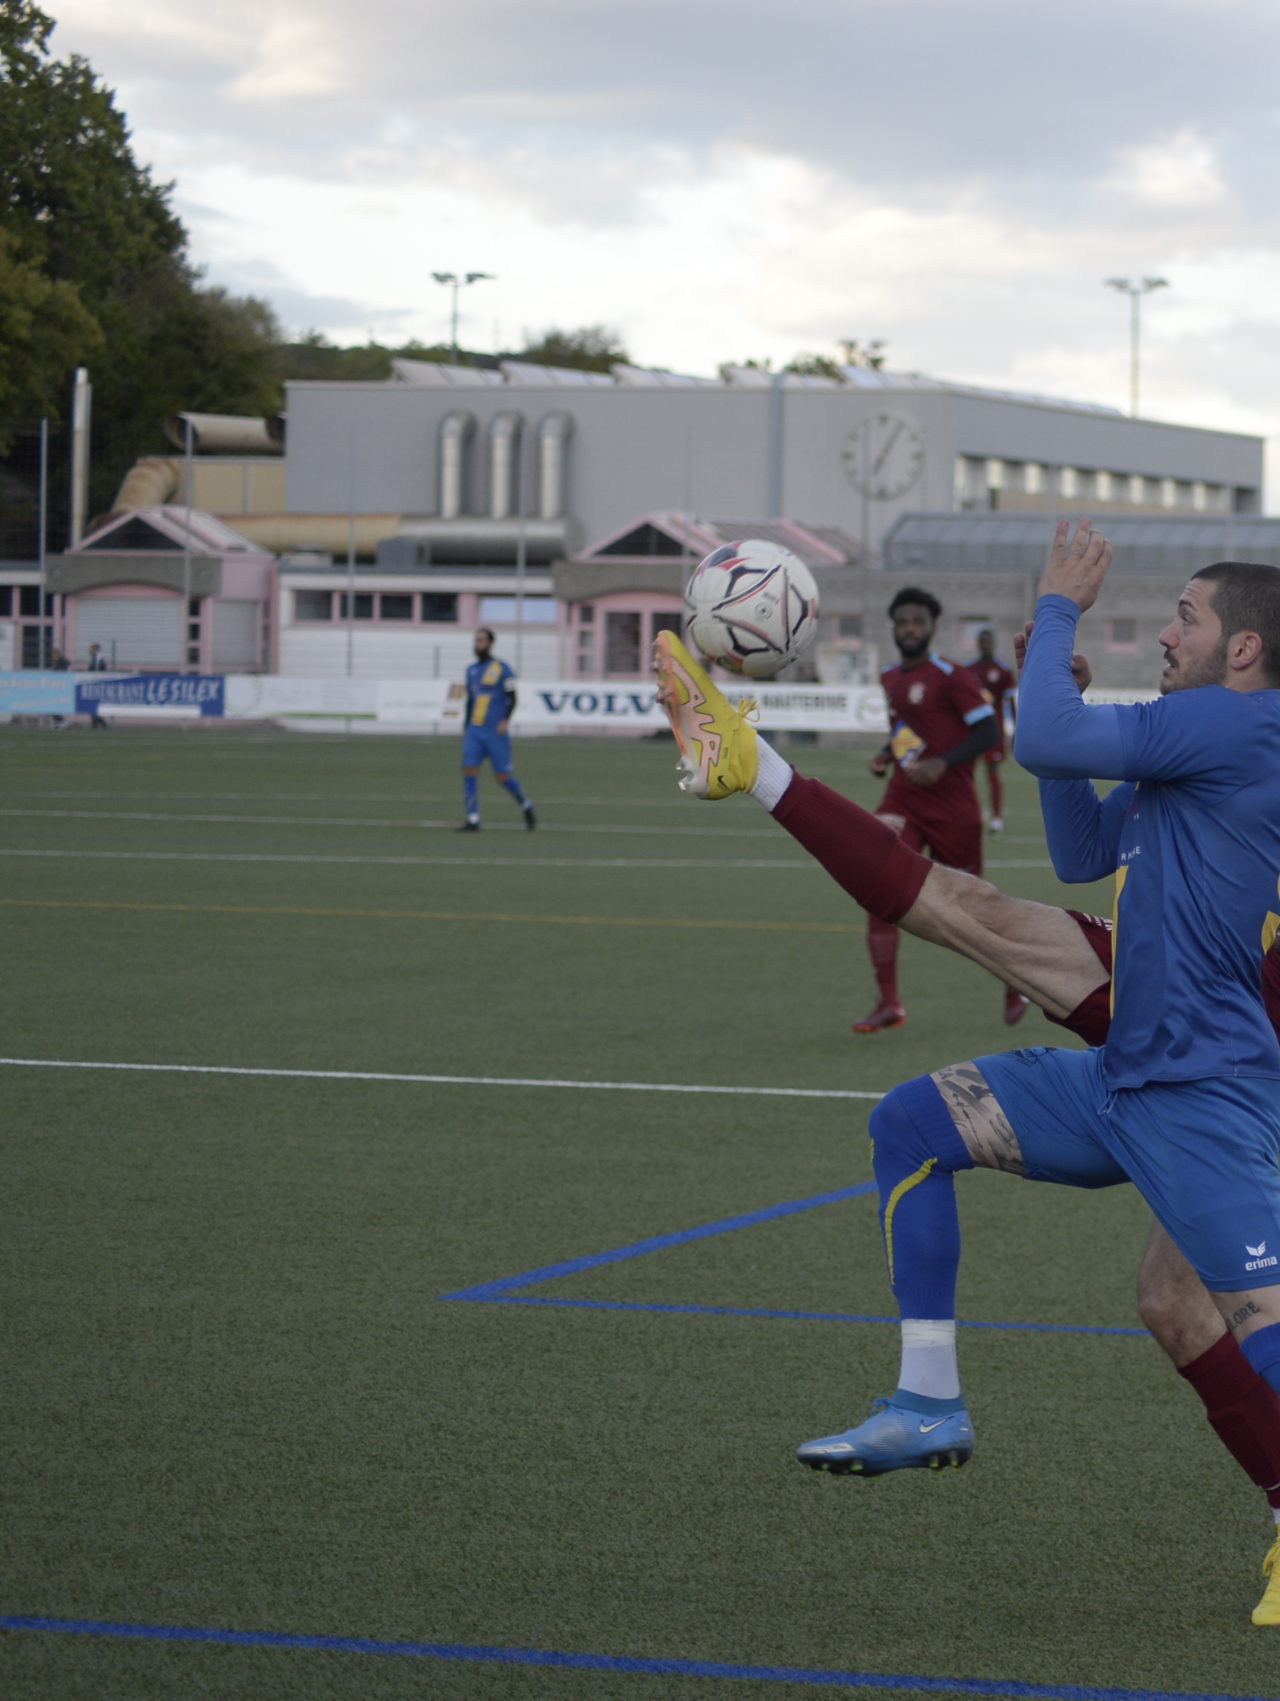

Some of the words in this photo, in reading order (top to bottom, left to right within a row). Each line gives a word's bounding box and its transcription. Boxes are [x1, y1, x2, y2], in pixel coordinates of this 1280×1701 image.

[171, 679, 220, 702] SILEX
[536, 690, 659, 715] VOLV
[1244, 1256, 1279, 1272] erima
[1226, 1301, 1261, 1332] LORE
